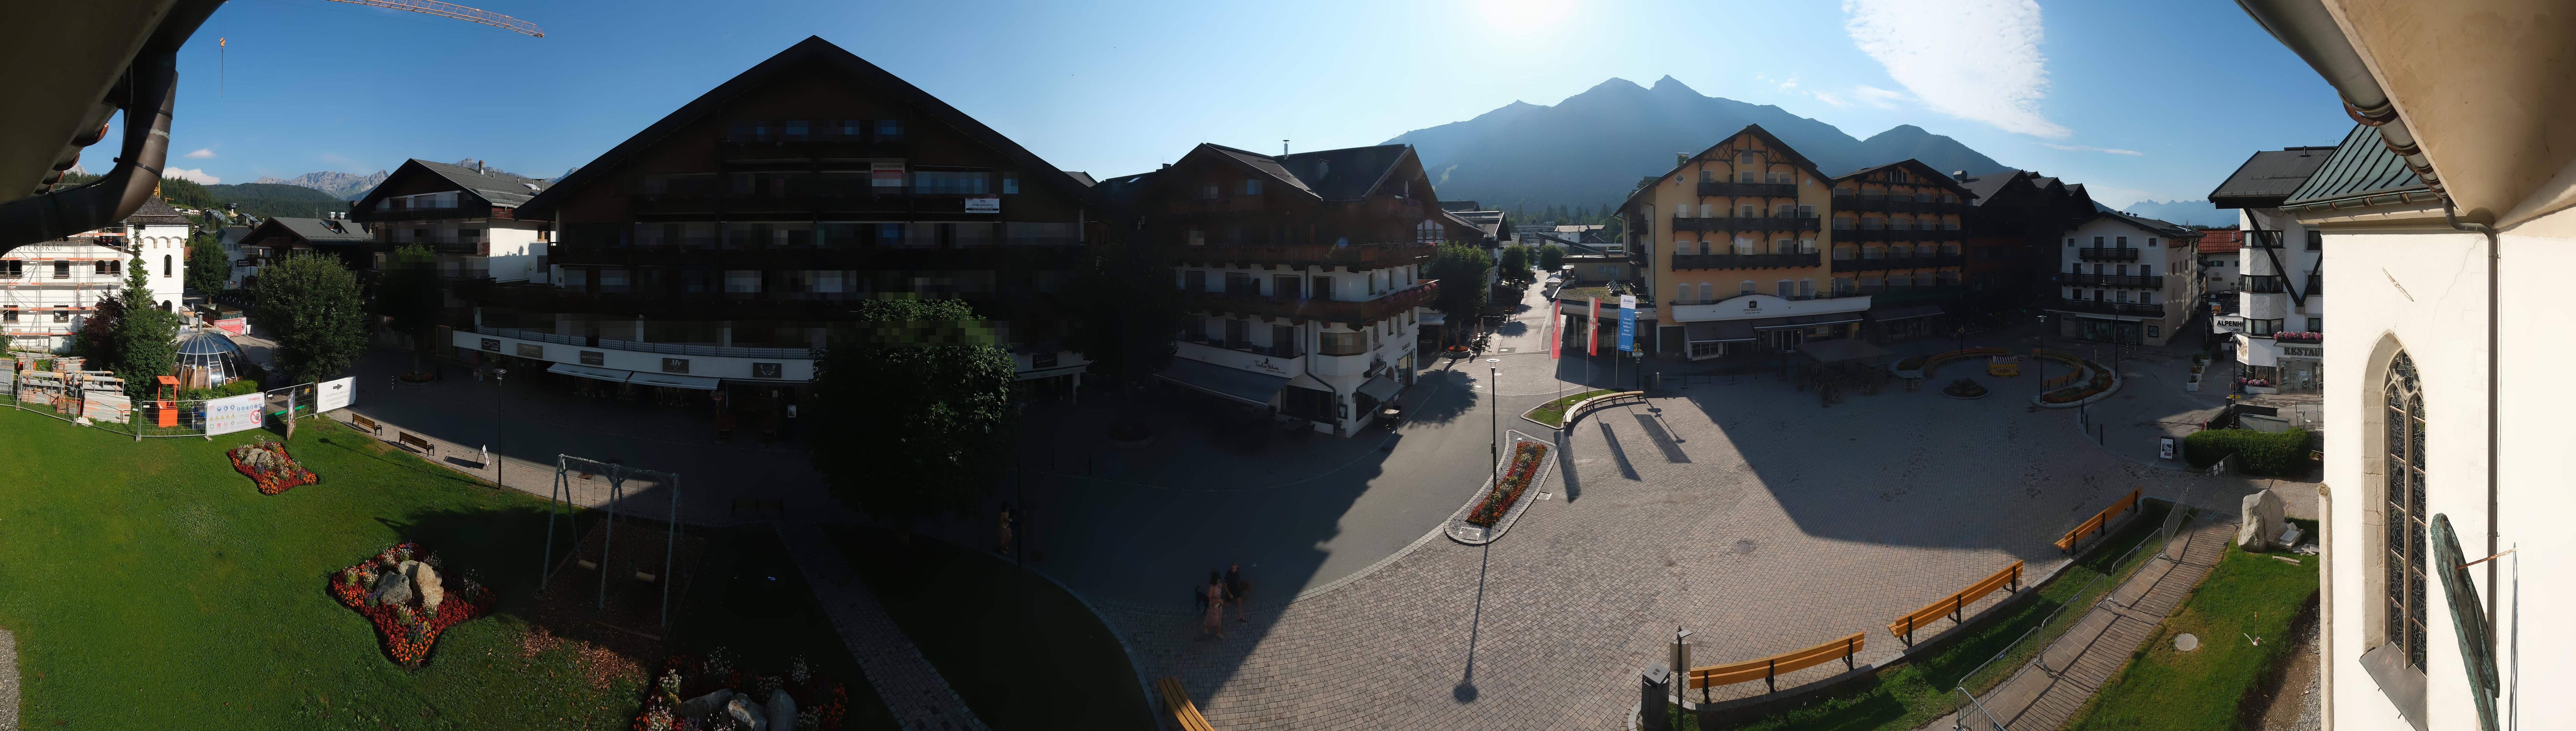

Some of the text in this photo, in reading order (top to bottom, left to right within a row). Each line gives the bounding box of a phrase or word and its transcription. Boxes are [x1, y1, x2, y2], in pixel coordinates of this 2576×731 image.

[1402, 342, 1410, 351] SAILER
[1371, 363, 1385, 376] RESTAURANT
[325, 394, 349, 402] KONGRESSZENTRUM
